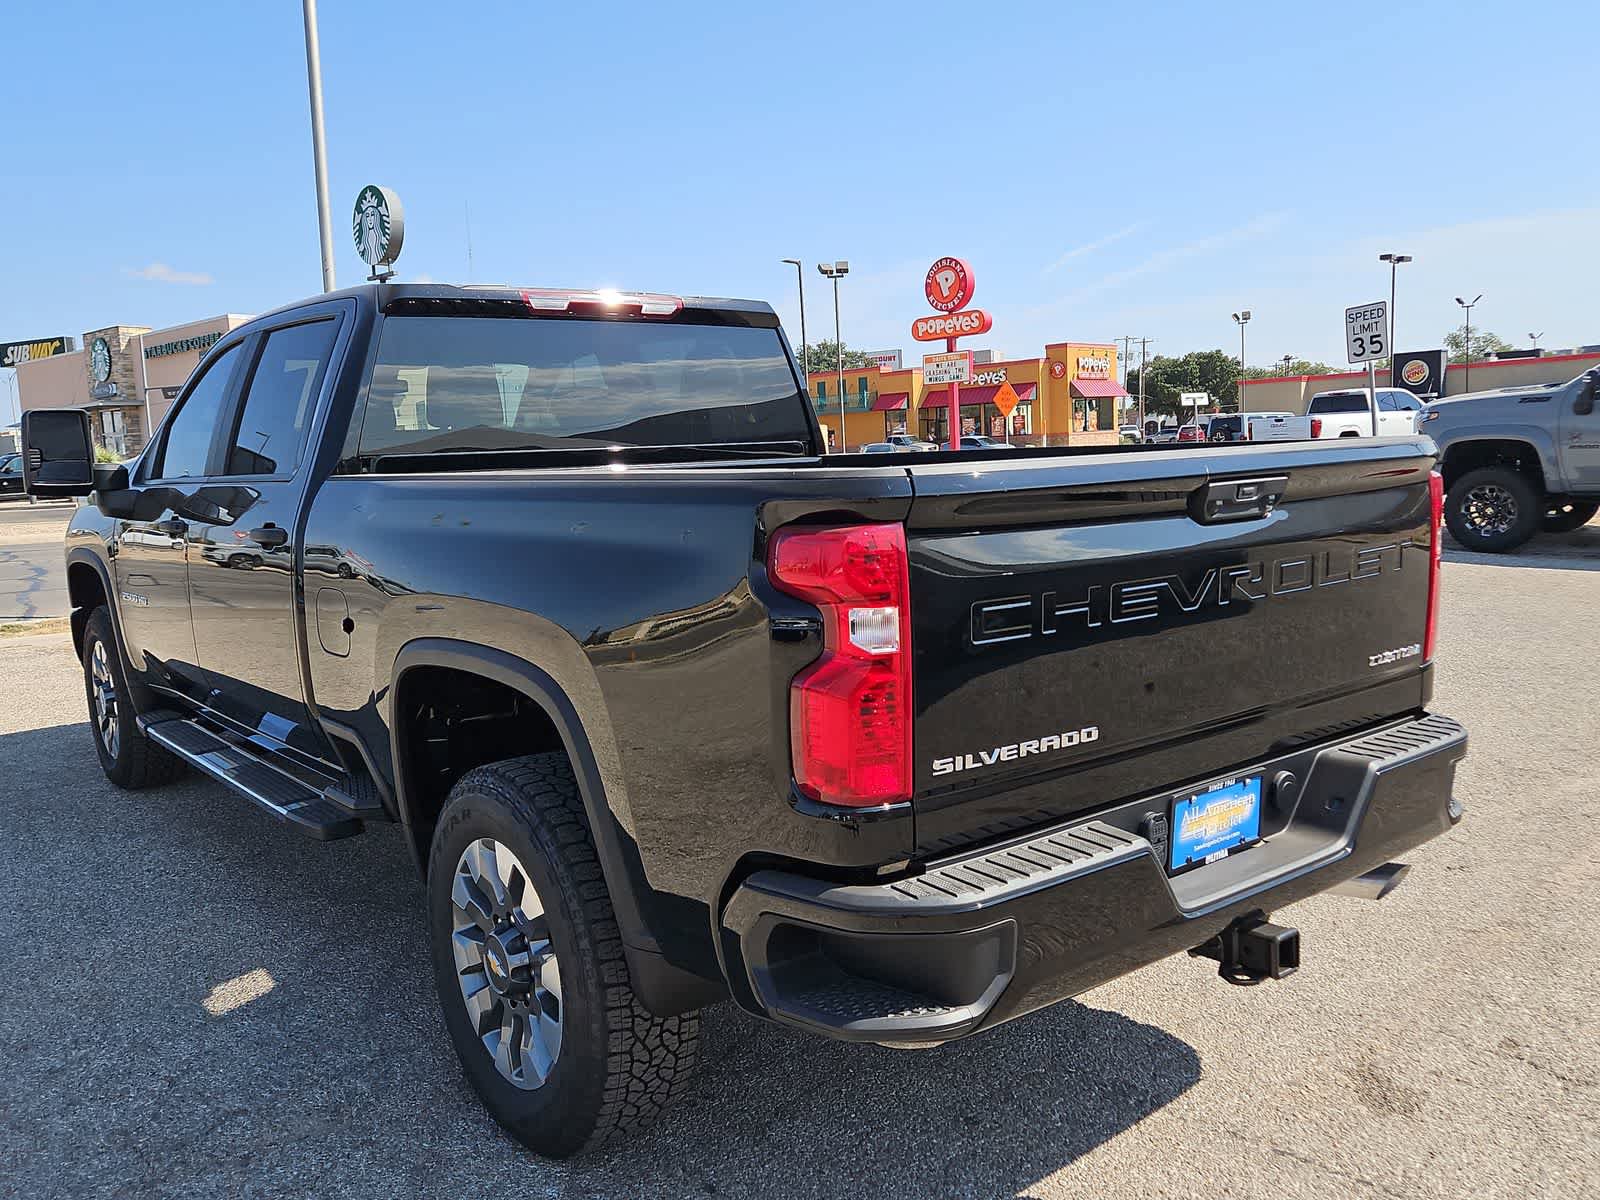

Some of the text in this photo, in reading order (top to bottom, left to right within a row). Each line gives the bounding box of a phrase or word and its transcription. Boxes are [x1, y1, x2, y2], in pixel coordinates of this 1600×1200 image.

[927, 258, 965, 283] LOUISIANA
[935, 270, 956, 297] P
[929, 290, 964, 310] KITCHEN
[1348, 307, 1385, 324] SPEED
[1352, 321, 1380, 336] LIMIT
[3, 340, 61, 364] SUBWAY
[1352, 334, 1383, 357] 35
[954, 367, 965, 375] THE
[970, 541, 1412, 646] CHEVROLET
[932, 726, 1099, 776] SILVERADO
